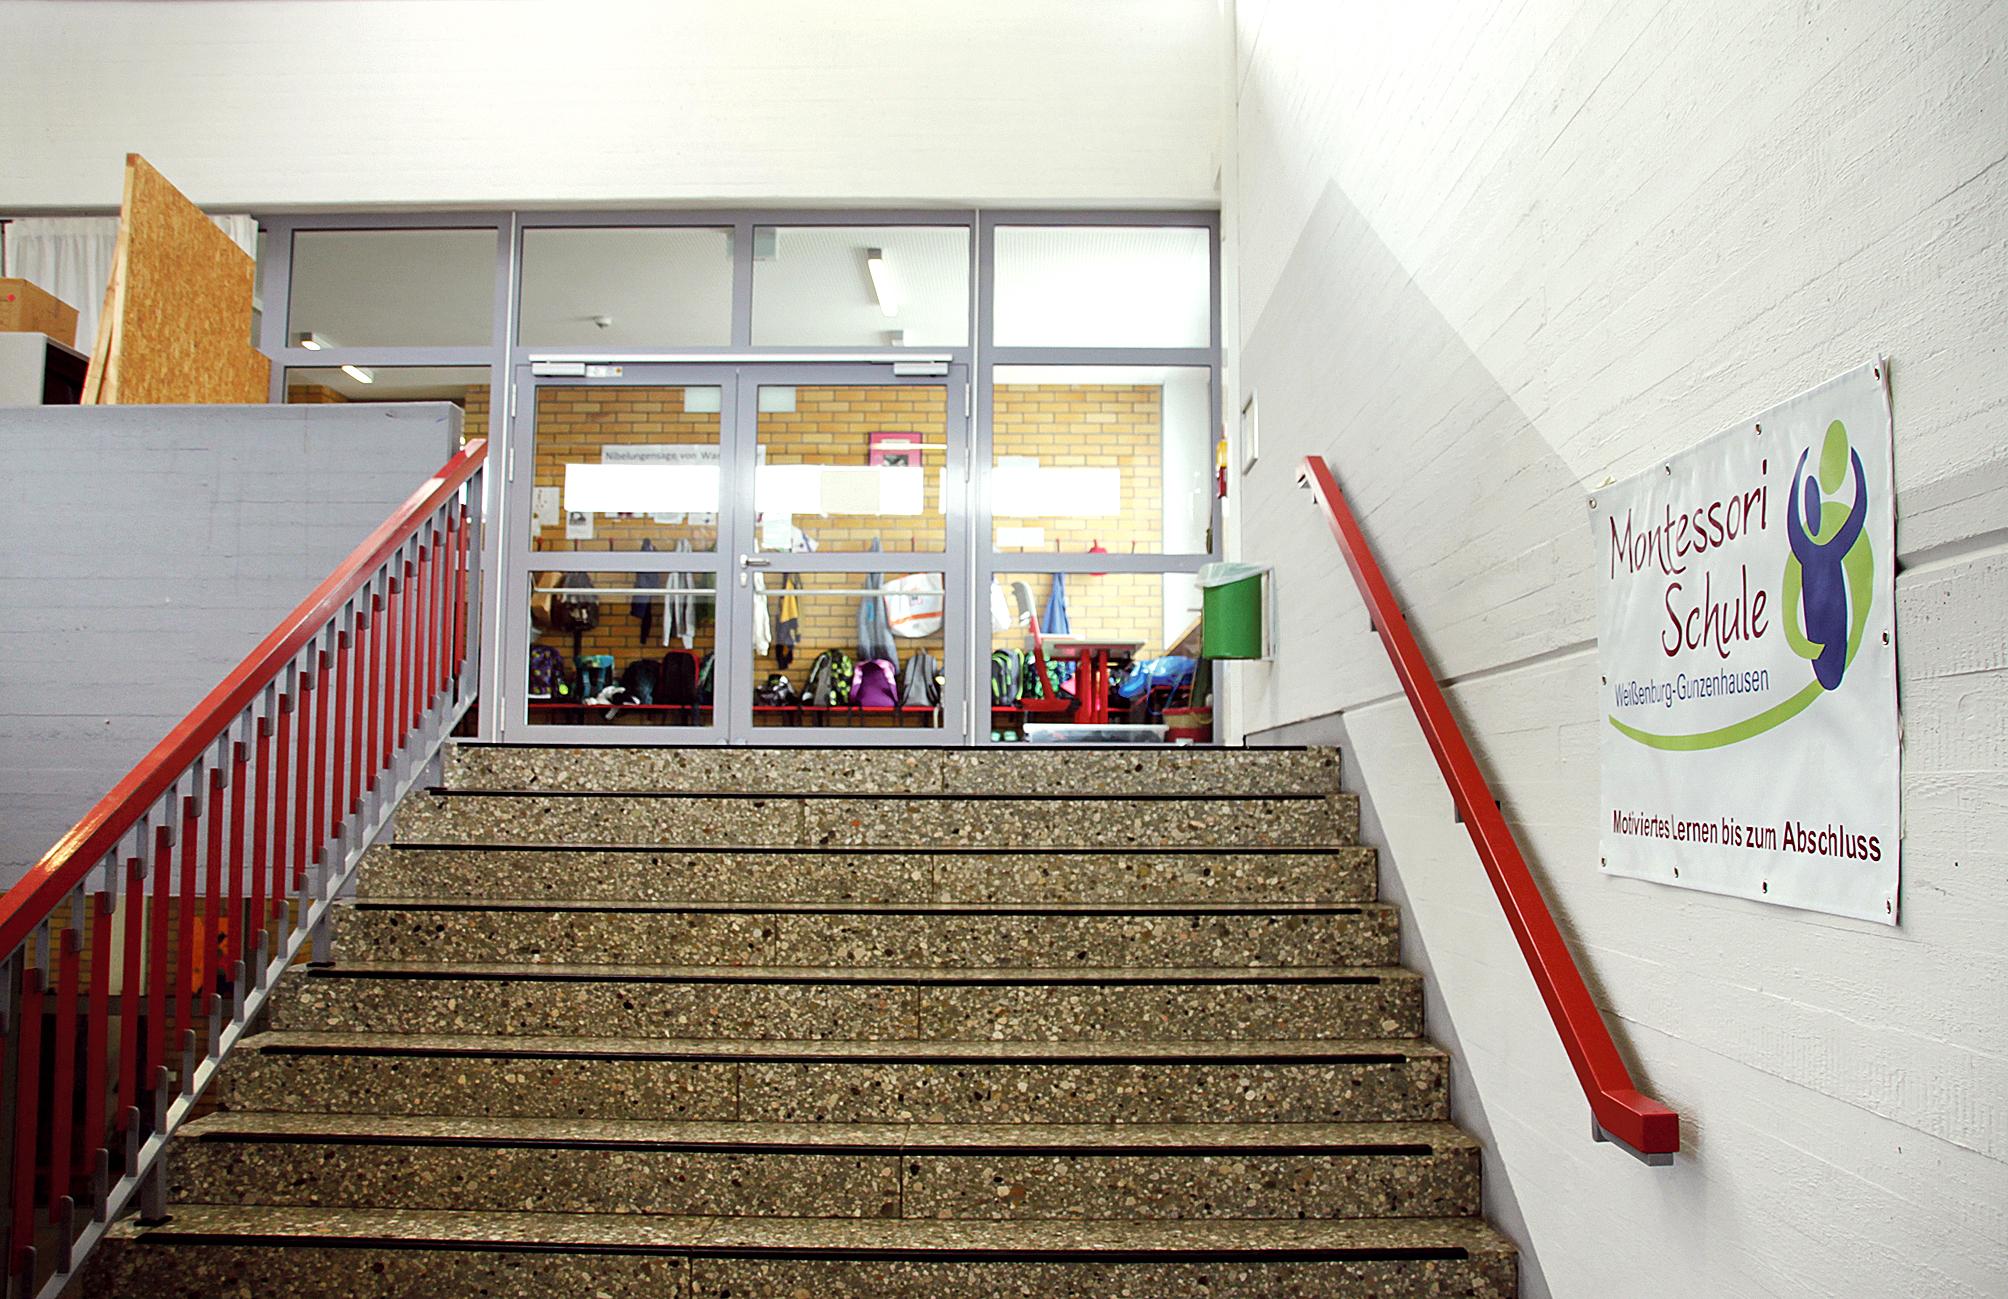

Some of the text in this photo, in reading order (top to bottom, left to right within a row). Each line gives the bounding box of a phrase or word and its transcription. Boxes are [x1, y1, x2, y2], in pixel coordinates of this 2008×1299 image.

[680, 452, 697, 460] von
[1609, 458, 1768, 580] Montessori
[1661, 564, 1769, 659] Schule
[1614, 667, 1770, 709] Weißenburg-Gunzenhausen
[1613, 809, 1882, 862] Motiviertes Lernen bis zum Abschluss
